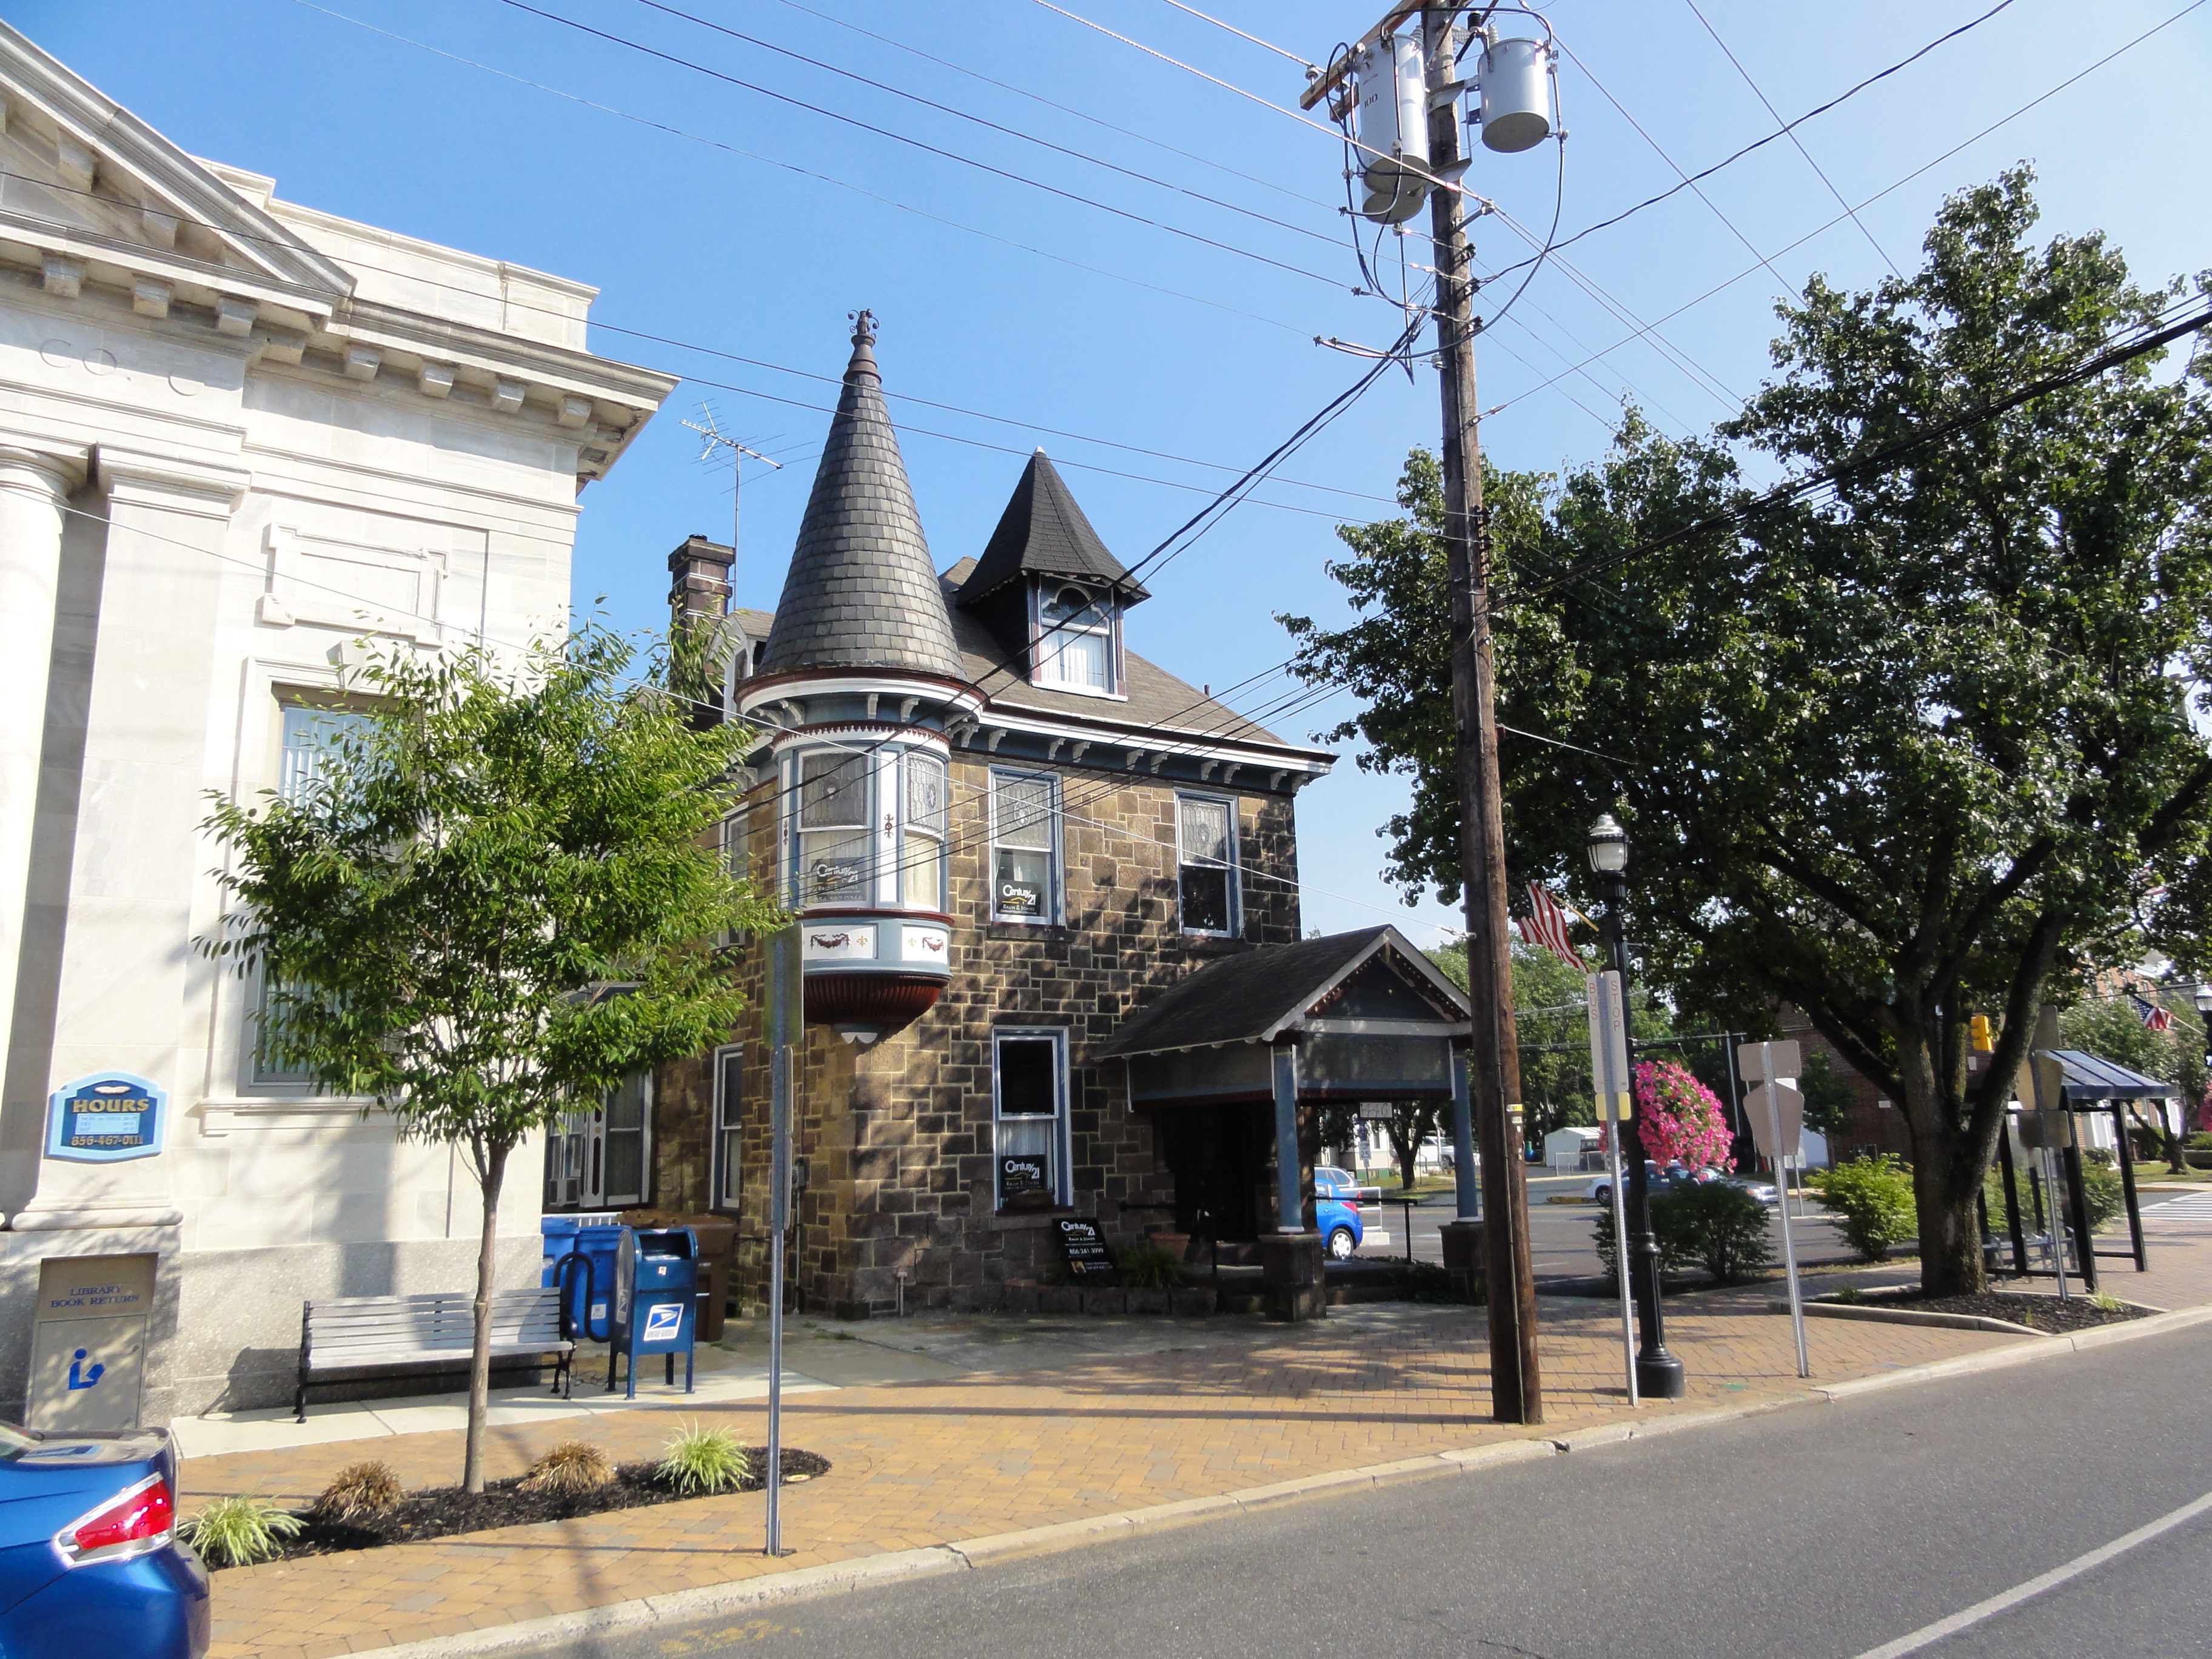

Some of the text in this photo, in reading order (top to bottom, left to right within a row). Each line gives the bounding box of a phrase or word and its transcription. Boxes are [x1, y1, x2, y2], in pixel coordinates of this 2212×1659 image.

[1002, 884, 1036, 905] Century 21
[1589, 983, 1598, 1019] BUS
[1610, 980, 1621, 1032] STOP
[72, 1098, 149, 1113] HOURS
[71, 1134, 143, 1146] 856-467-0111
[1361, 1150, 1370, 1159] 25
[1005, 1160, 1040, 1179] Century 21
[1061, 1221, 1095, 1236] Century 21
[70, 1285, 124, 1296] LIBRARY
[50, 1294, 140, 1308] BOOK RETURN
